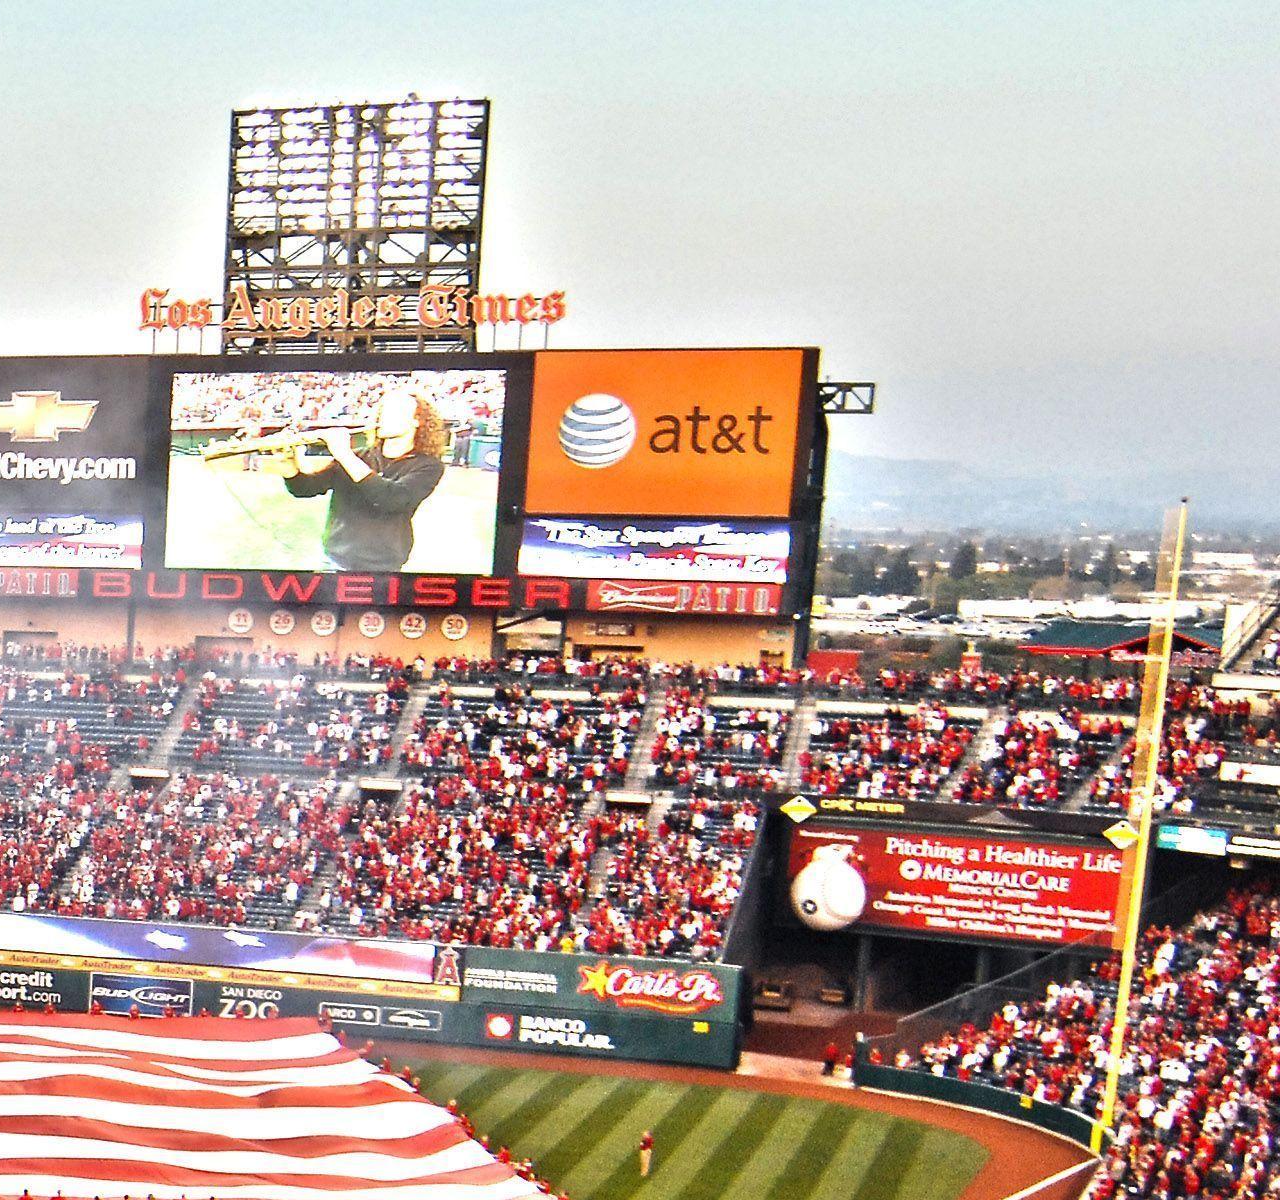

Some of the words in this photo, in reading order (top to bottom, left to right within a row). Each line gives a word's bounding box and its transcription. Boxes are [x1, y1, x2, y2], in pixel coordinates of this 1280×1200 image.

[138, 288, 212, 331] Los
[222, 284, 404, 338] Angeles
[417, 284, 567, 328] Times
[649, 403, 773, 457] at&t
[92, 571, 572, 609] BUDWEISER
[885, 837, 964, 865] Pitching
[968, 849, 980, 862] a
[985, 845, 1079, 869] Healthier
[1082, 853, 1123, 873] Life
[8, 954, 60, 966] AutoTrader
[81, 959, 133, 971] AutoTrader
[154, 965, 207, 977] AutoTrader
[221, 986, 244, 997] SAN
[247, 988, 284, 1001] DIEGO
[464, 978, 558, 994] FOUNDATION
[605, 968, 681, 996] Carl's
[679, 973, 721, 1002] Jr.
[92, 986, 132, 999] BUD
[136, 991, 190, 1003] LIGHT
[219, 998, 280, 1019] ZOO
[520, 1015, 586, 1033] BANCO
